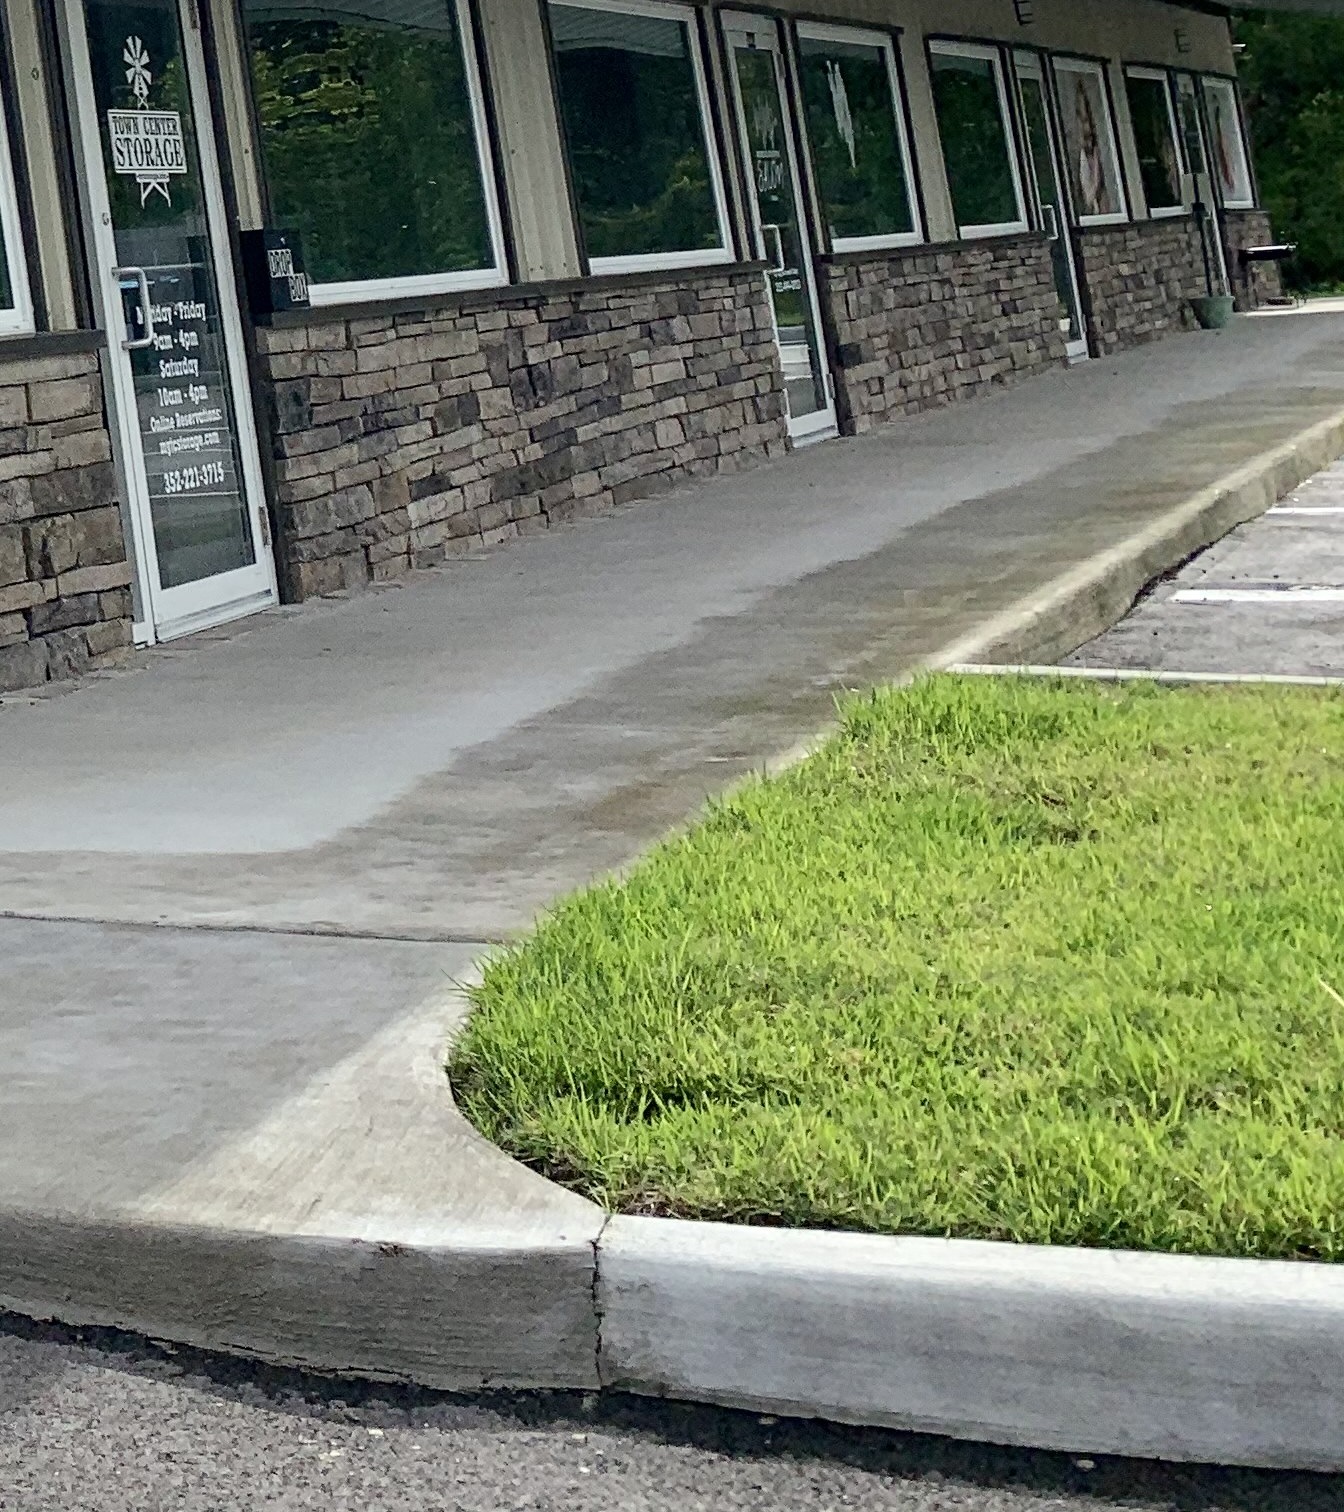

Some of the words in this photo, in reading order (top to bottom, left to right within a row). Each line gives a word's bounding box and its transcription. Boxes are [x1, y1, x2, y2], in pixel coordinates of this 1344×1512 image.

[111, 115, 139, 135] TOWN
[143, 116, 179, 136] CENTER
[115, 137, 183, 167] STORAGE
[267, 249, 294, 279] DROP
[288, 273, 309, 302] BOX
[177, 300, 207, 322] Friday
[152, 332, 174, 352] 9am
[179, 329, 200, 351] 4pm
[159, 355, 199, 379] Saturday
[157, 386, 184, 407] 10am
[188, 382, 209, 405] 4pm
[150, 415, 175, 432] Online
[163, 461, 225, 494] 352-221-3715
